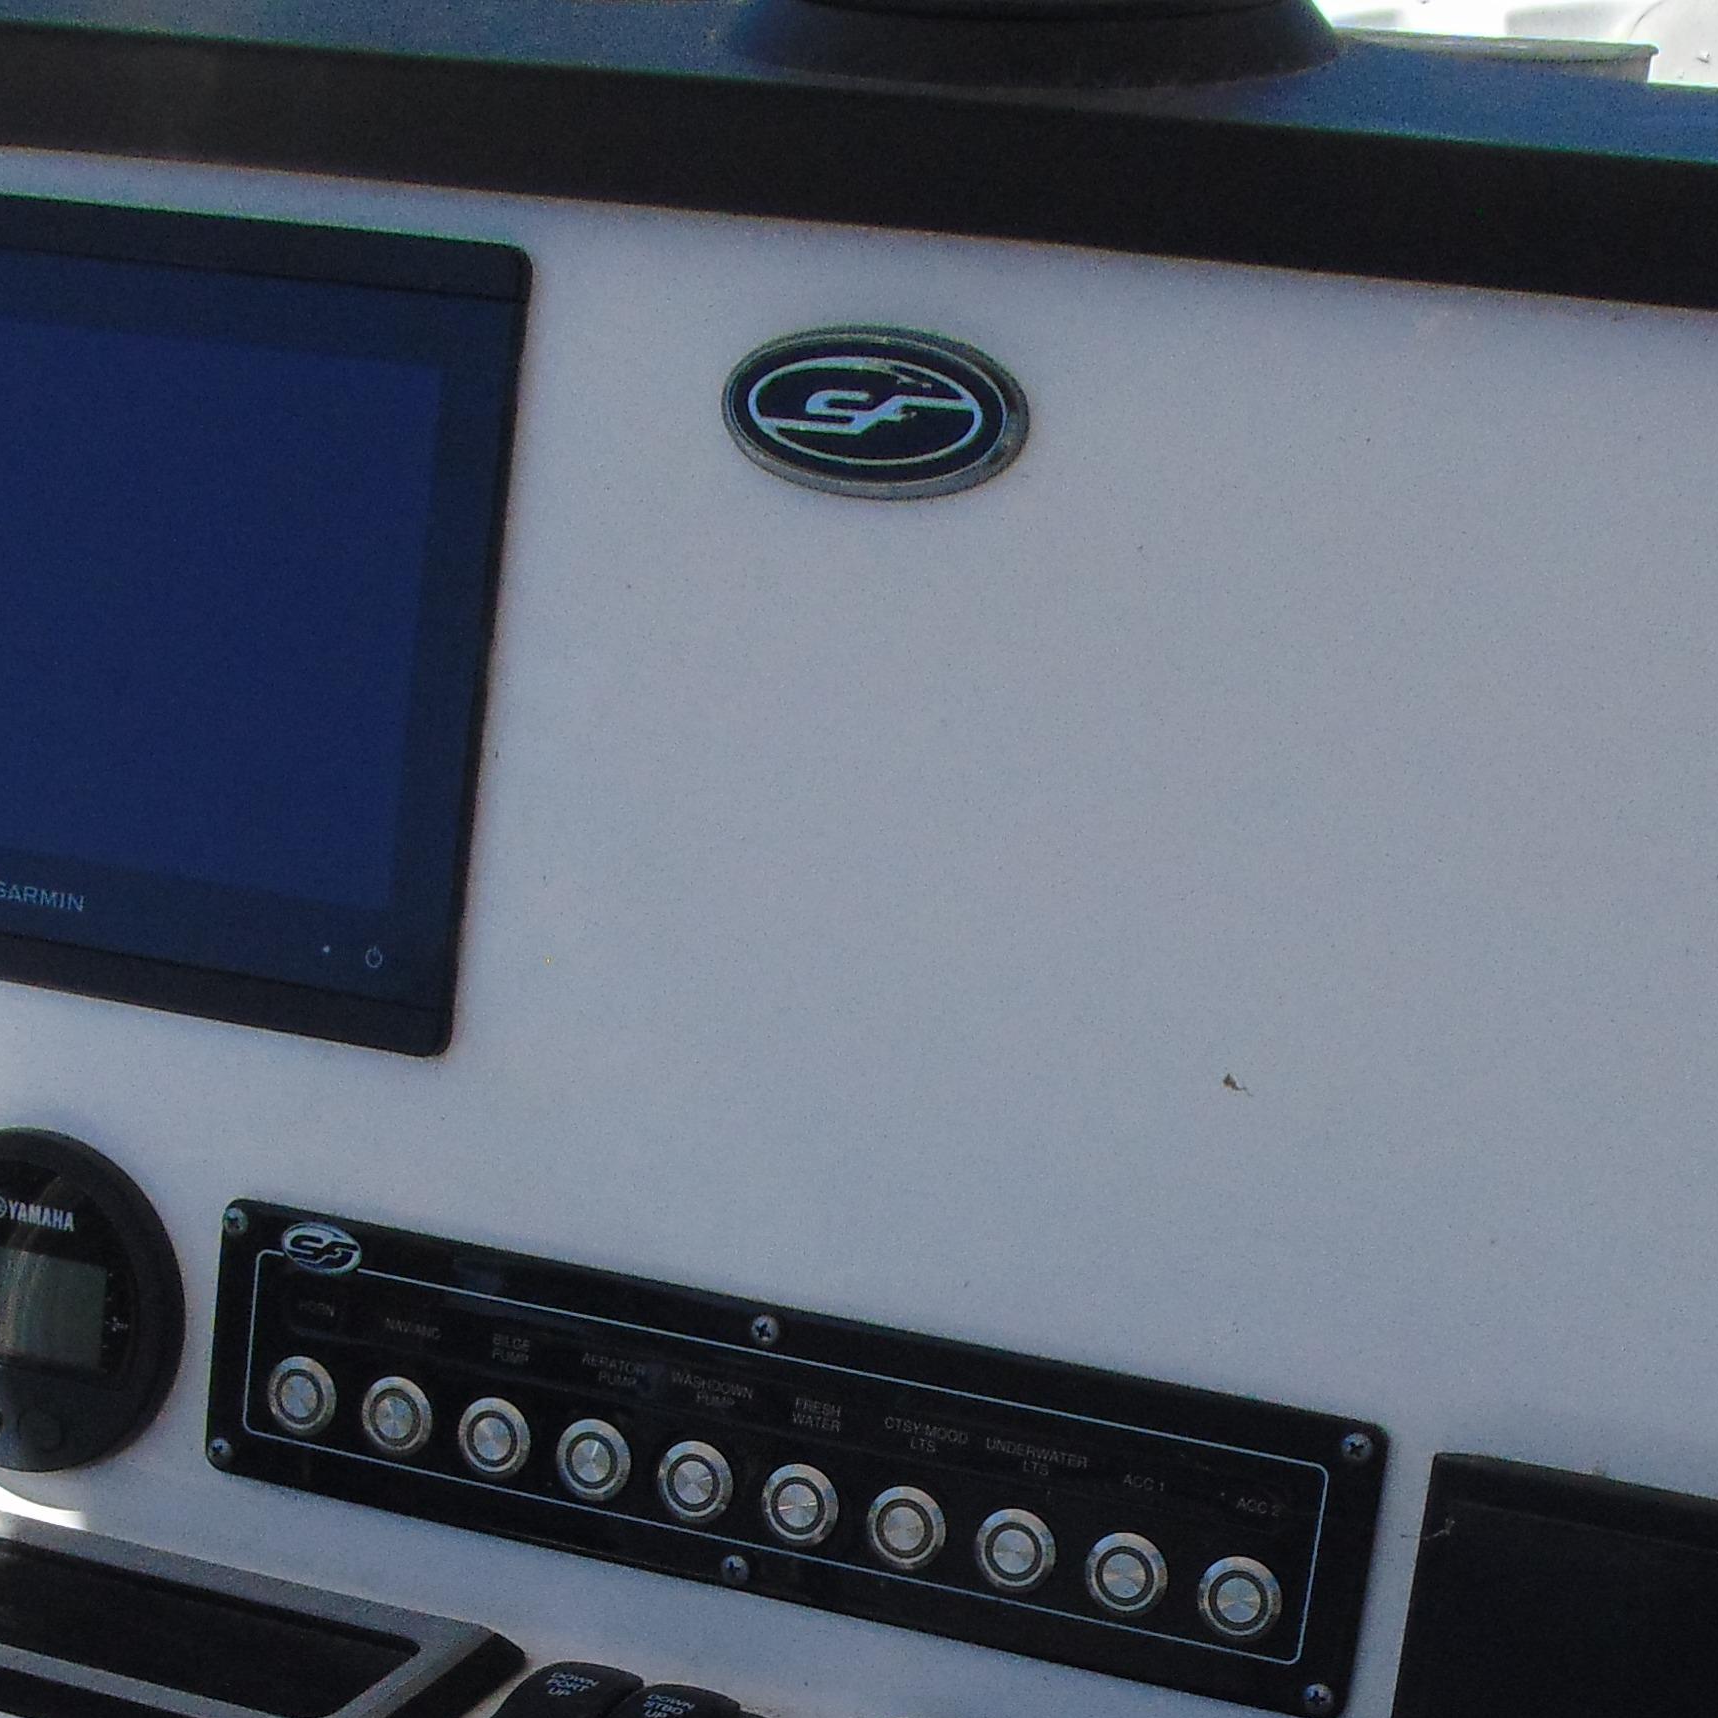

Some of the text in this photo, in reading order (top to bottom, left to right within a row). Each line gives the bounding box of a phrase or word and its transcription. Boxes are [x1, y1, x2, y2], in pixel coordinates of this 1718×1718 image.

[7, 1199, 75, 1232] YAMAHA
[491, 1333, 531, 1352] BILGE
[491, 1347, 530, 1365] PUMP
[582, 1352, 647, 1376] AERATOR
[597, 1371, 638, 1388] PUMP
[672, 1371, 754, 1400] WASHDOWN
[794, 1396, 842, 1418] FRESH
[792, 1411, 841, 1433] WATER
[910, 1438, 936, 1453] LTS
[986, 1436, 1089, 1470] UNDERWATER
[1022, 1460, 1049, 1477] LTS
[1123, 1473, 1155, 1491] ACC
[1236, 1497, 1268, 1514] ACC
[546, 1677, 589, 1693] PORT
[550, 1671, 600, 1688] DOWN
[547, 1687, 572, 1697] UP
[647, 1693, 696, 1710] DOWN
